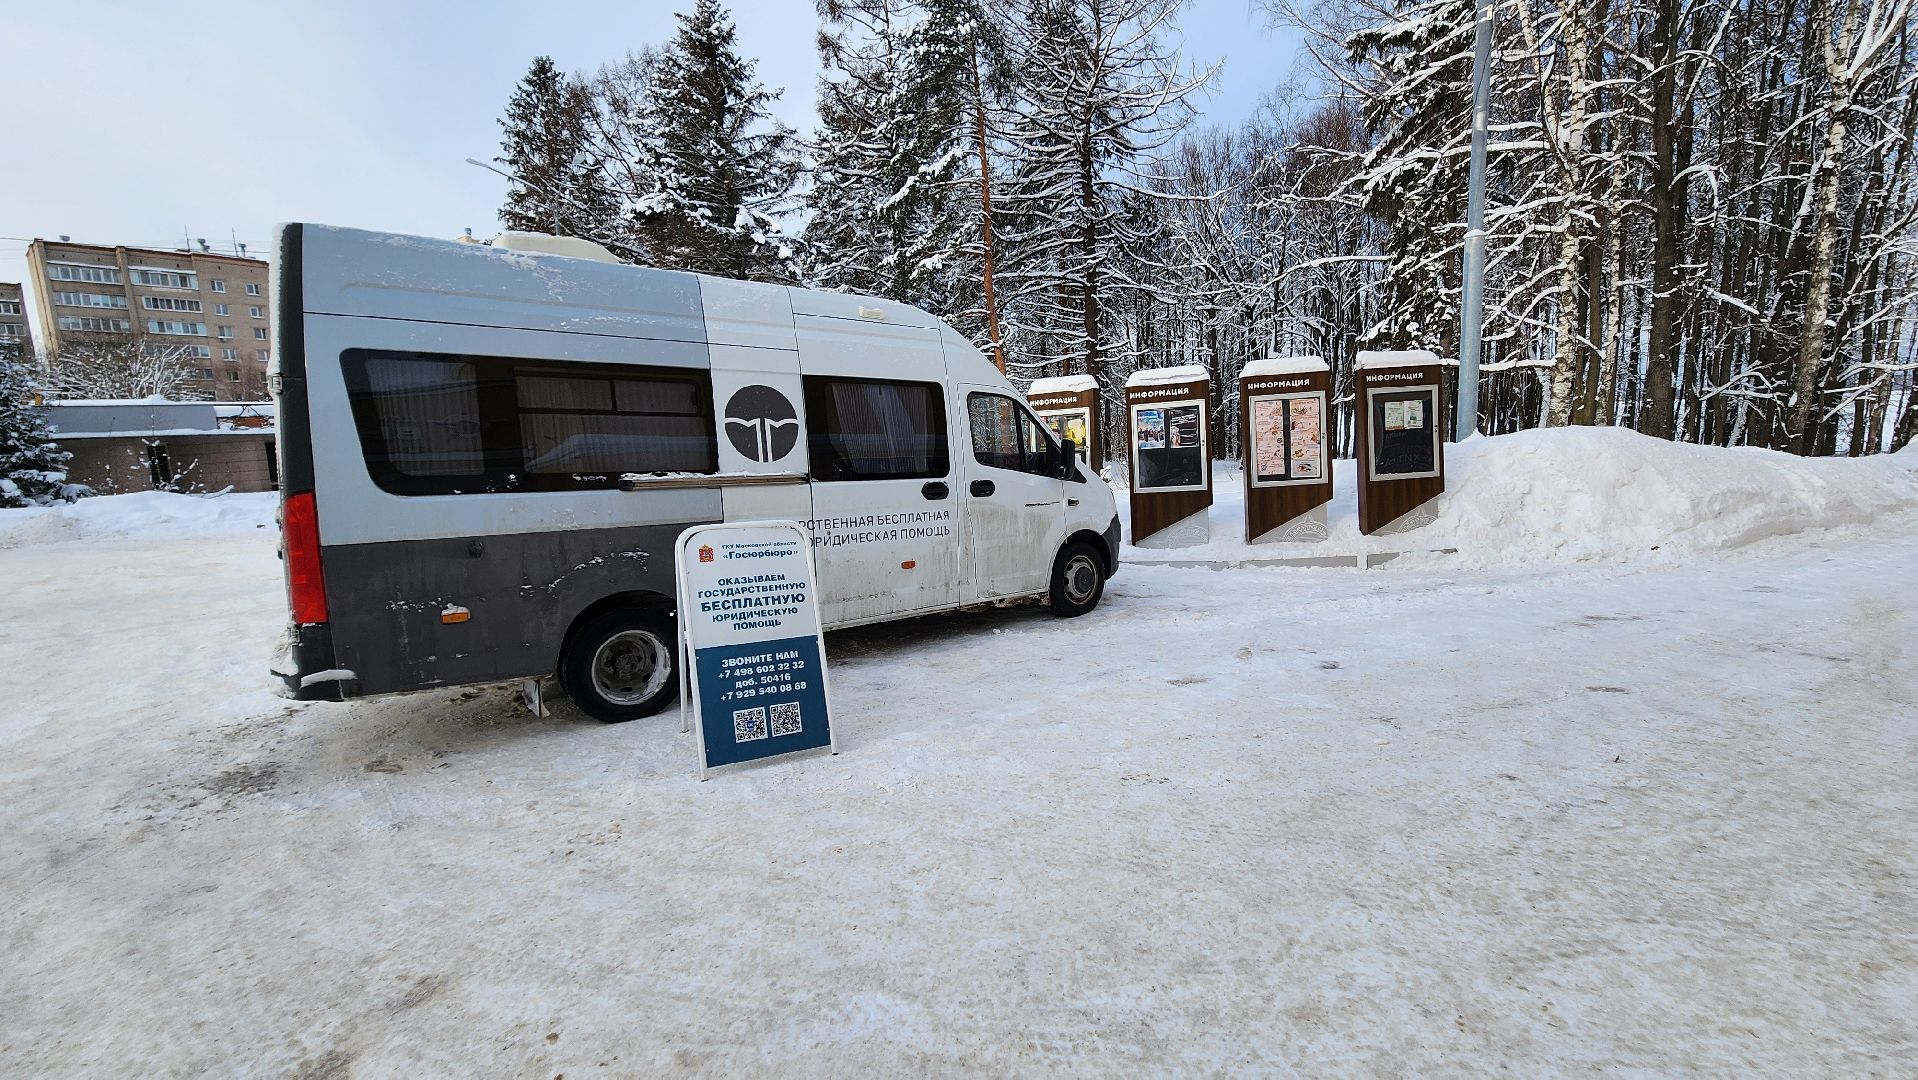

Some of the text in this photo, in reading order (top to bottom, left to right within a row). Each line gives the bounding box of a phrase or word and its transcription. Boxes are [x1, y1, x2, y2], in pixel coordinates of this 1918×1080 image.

[1247, 378, 1310, 390] ИНФОРМАЦИЯ
[1366, 372, 1424, 382] ИНФОРМАЦИЯ
[1129, 387, 1189, 399] ИНФОРМАЦИЯ
[1029, 396, 1077, 407] ИНФОРМАЦИЯ
[877, 510, 950, 525] БЕСПЛАТНАЯ
[900, 525, 950, 540] ПОМОЩЬ
[735, 541, 772, 549] Московской
[723, 549, 798, 560] «Госюрбюро»
[717, 574, 786, 586] ОКАЗЫВАЕМ
[698, 582, 806, 598] ГОСУДАРСТВЕННУЮ
[701, 593, 806, 612] БЕСПЛАТНУЮ
[712, 607, 798, 622] ЮРИДИЧЕСКУЮ
[733, 619, 782, 631] ПОМОЩЬ
[721, 650, 799, 668] ЗВОНИТЕ НАМ
[718, 661, 805, 679] +7 498 602 32 32
[735, 673, 791, 689] доб. 50416
[720, 692, 733, 701] +7
[736, 689, 756, 699] 929
[759, 686, 777, 696] 540
[780, 684, 792, 693] 08
